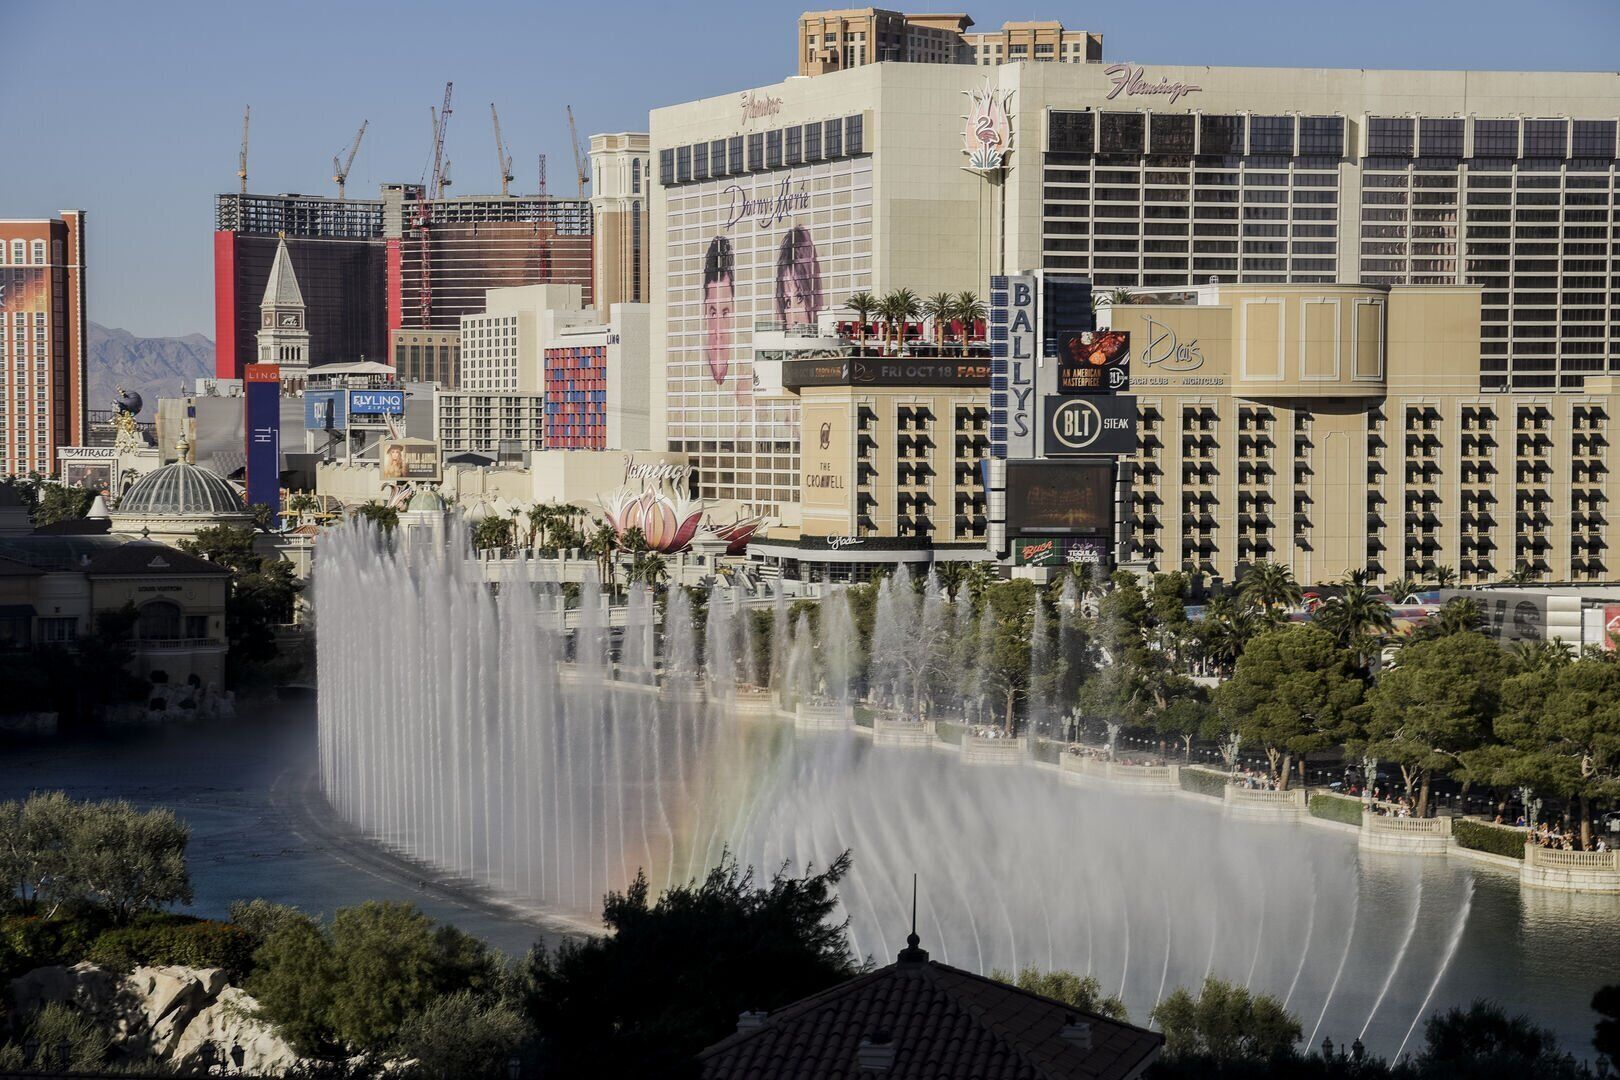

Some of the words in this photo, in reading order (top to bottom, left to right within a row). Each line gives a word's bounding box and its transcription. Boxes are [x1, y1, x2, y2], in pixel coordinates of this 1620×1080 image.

[1104, 64, 1203, 104] Flamingo
[1140, 314, 1204, 372] Drai's
[1009, 282, 1033, 437] BALLYS
[881, 366, 902, 377] FRI
[906, 366, 935, 378] OCT
[939, 366, 952, 377] 18
[1063, 369, 1071, 377] AN
[1073, 368, 1101, 378] AMERICAN
[1063, 378, 1100, 387] MASTERPIECE
[1129, 377, 1148, 385] EACH
[1149, 377, 1169, 385] CLUB
[1182, 377, 1224, 385] NIGHTCLUB
[1064, 410, 1092, 436] BLT
[1104, 418, 1129, 429] STEAK
[75, 448, 115, 457] MIRAGE
[820, 462, 831, 471] THE
[806, 474, 844, 489] CROMWELL
